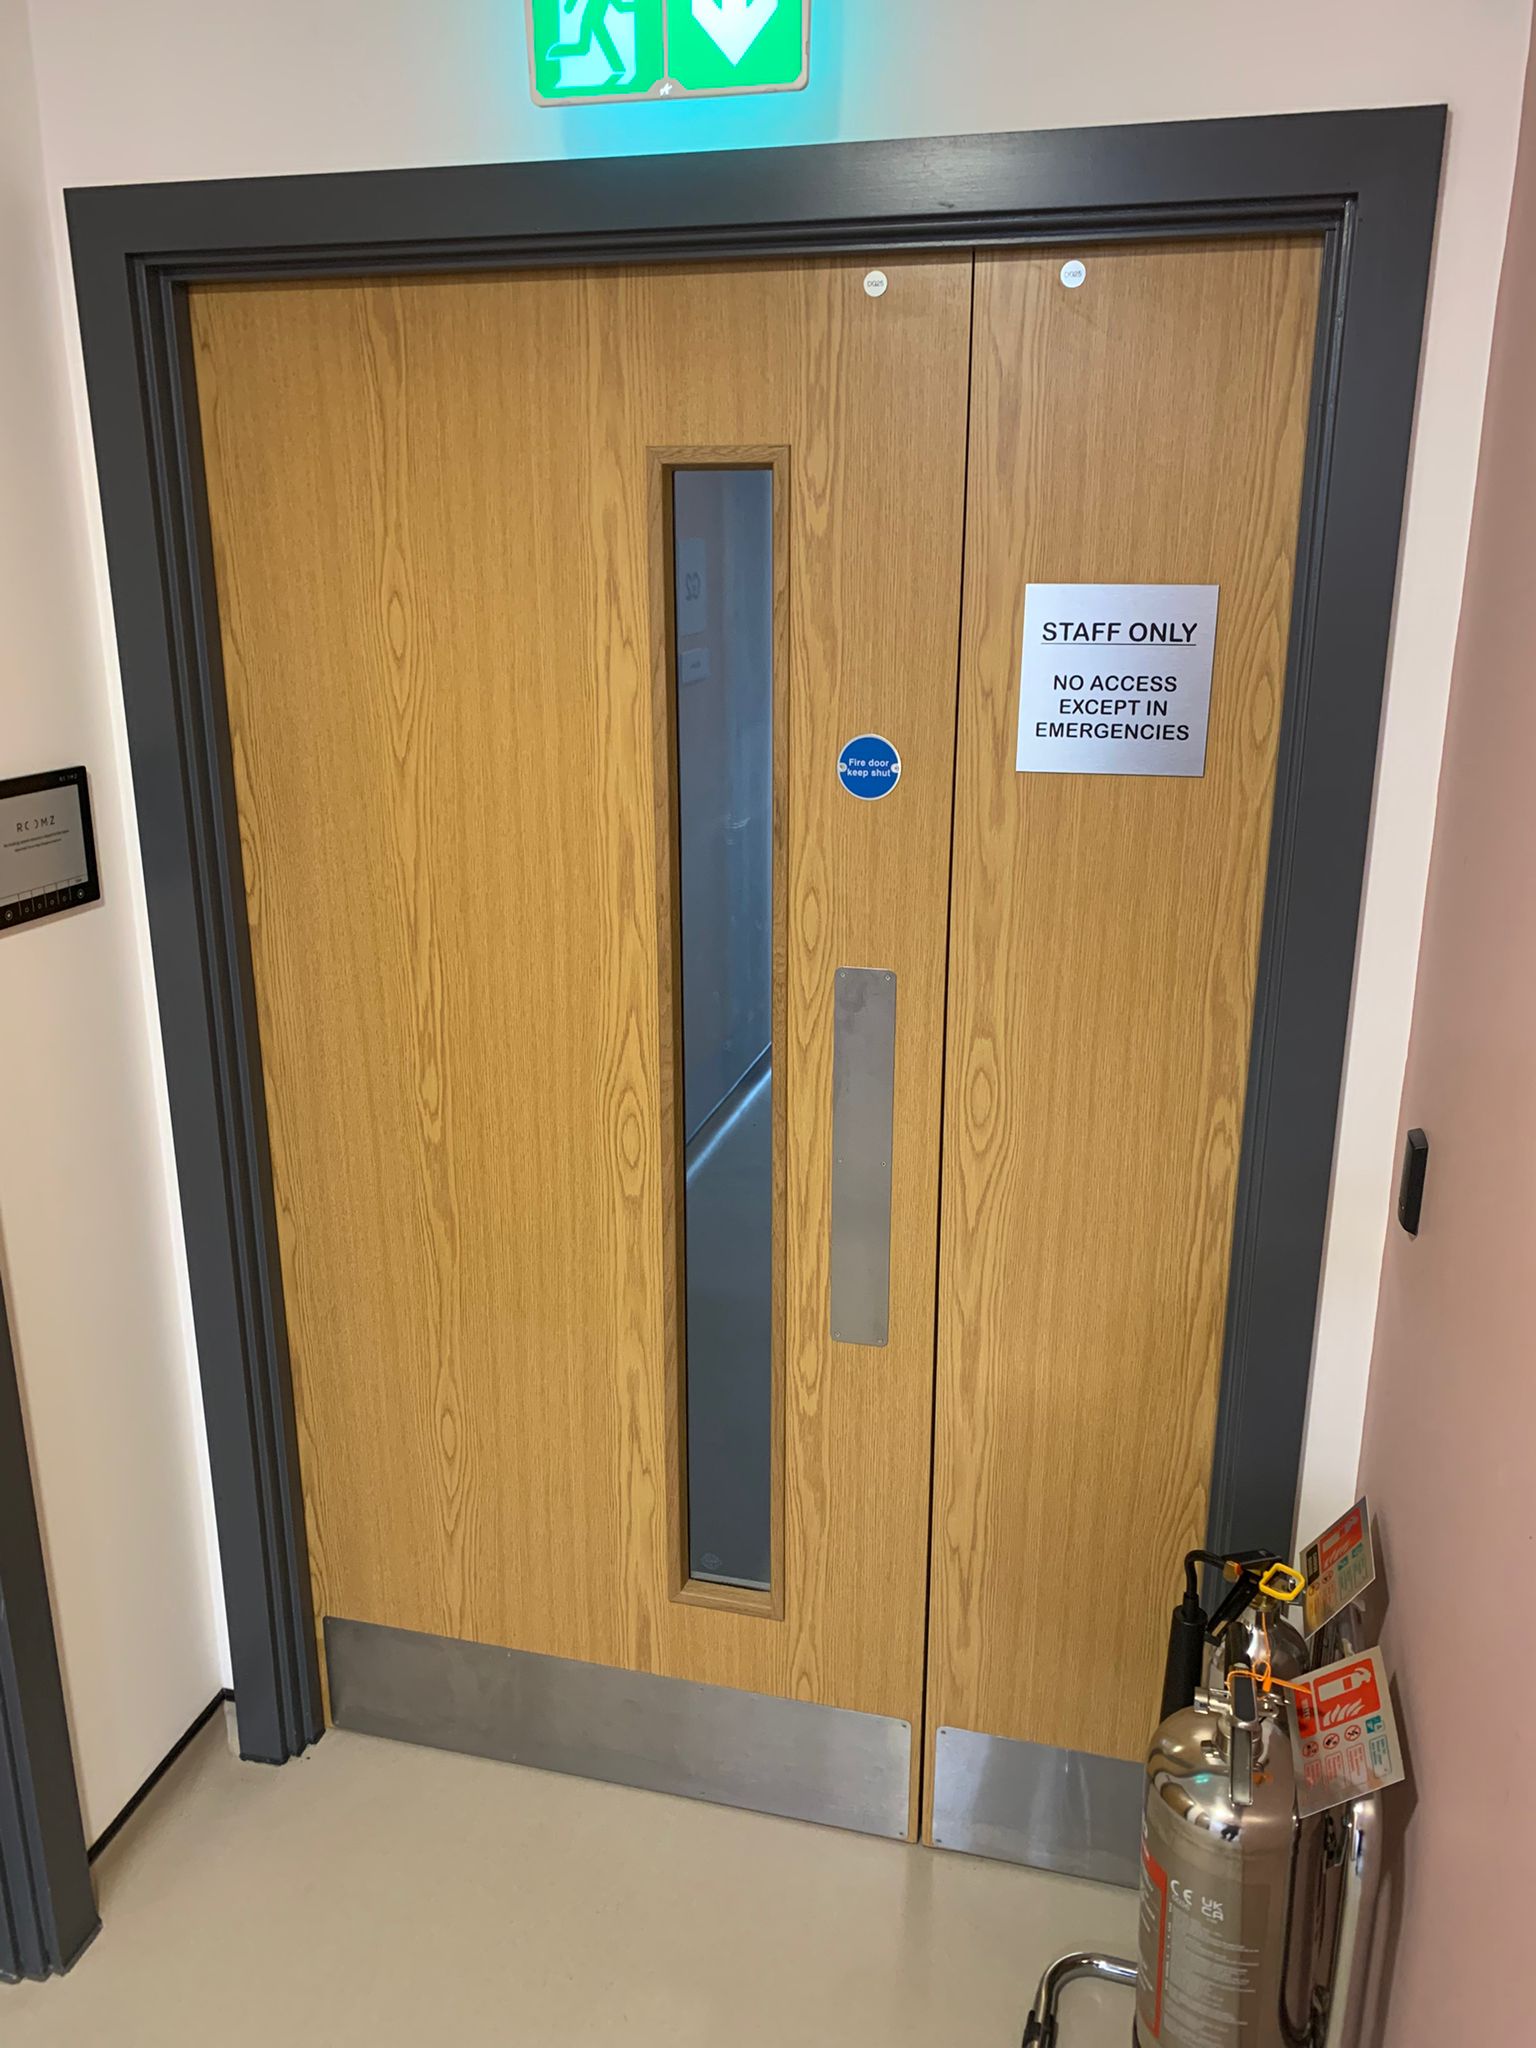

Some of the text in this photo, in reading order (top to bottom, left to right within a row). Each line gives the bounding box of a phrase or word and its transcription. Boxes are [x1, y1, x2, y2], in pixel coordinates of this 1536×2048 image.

[1042, 622, 1198, 643] STAFF ONLY
[1053, 674, 1178, 692] NO ACCESS
[1059, 699, 1168, 716] EXCEPT IN
[1035, 722, 1190, 741] EMERGENCIES
[848, 758, 889, 767] Fire door
[847, 769, 891, 778] keep shut
[1170, 1880, 1193, 1906] CE
[1201, 1896, 1223, 1910] UK
